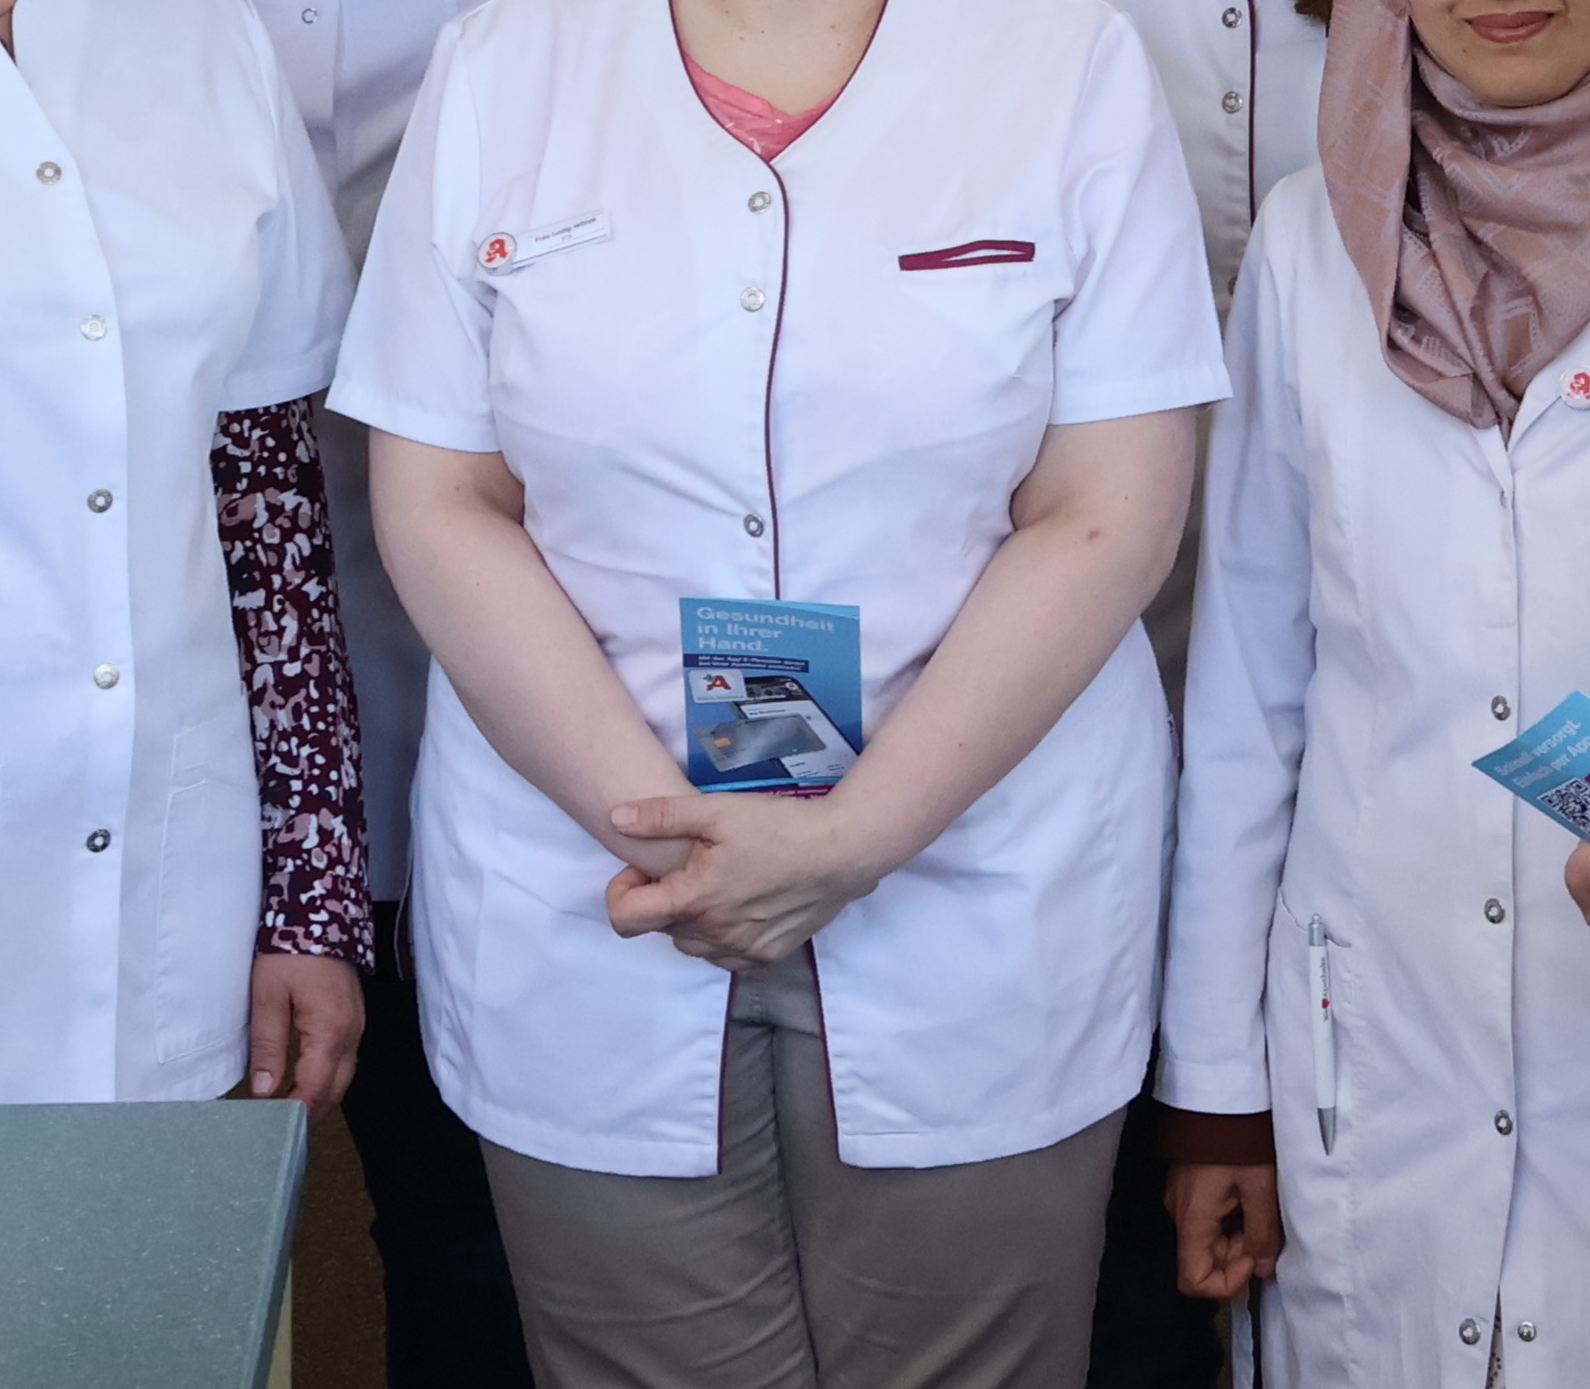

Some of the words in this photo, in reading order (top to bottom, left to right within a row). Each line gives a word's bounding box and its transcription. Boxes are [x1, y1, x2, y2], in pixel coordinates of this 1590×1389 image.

[697, 607, 835, 632] Gesundheit
[698, 623, 719, 634] in
[726, 624, 782, 638] Ihrer
[698, 638, 769, 651] Hand.
